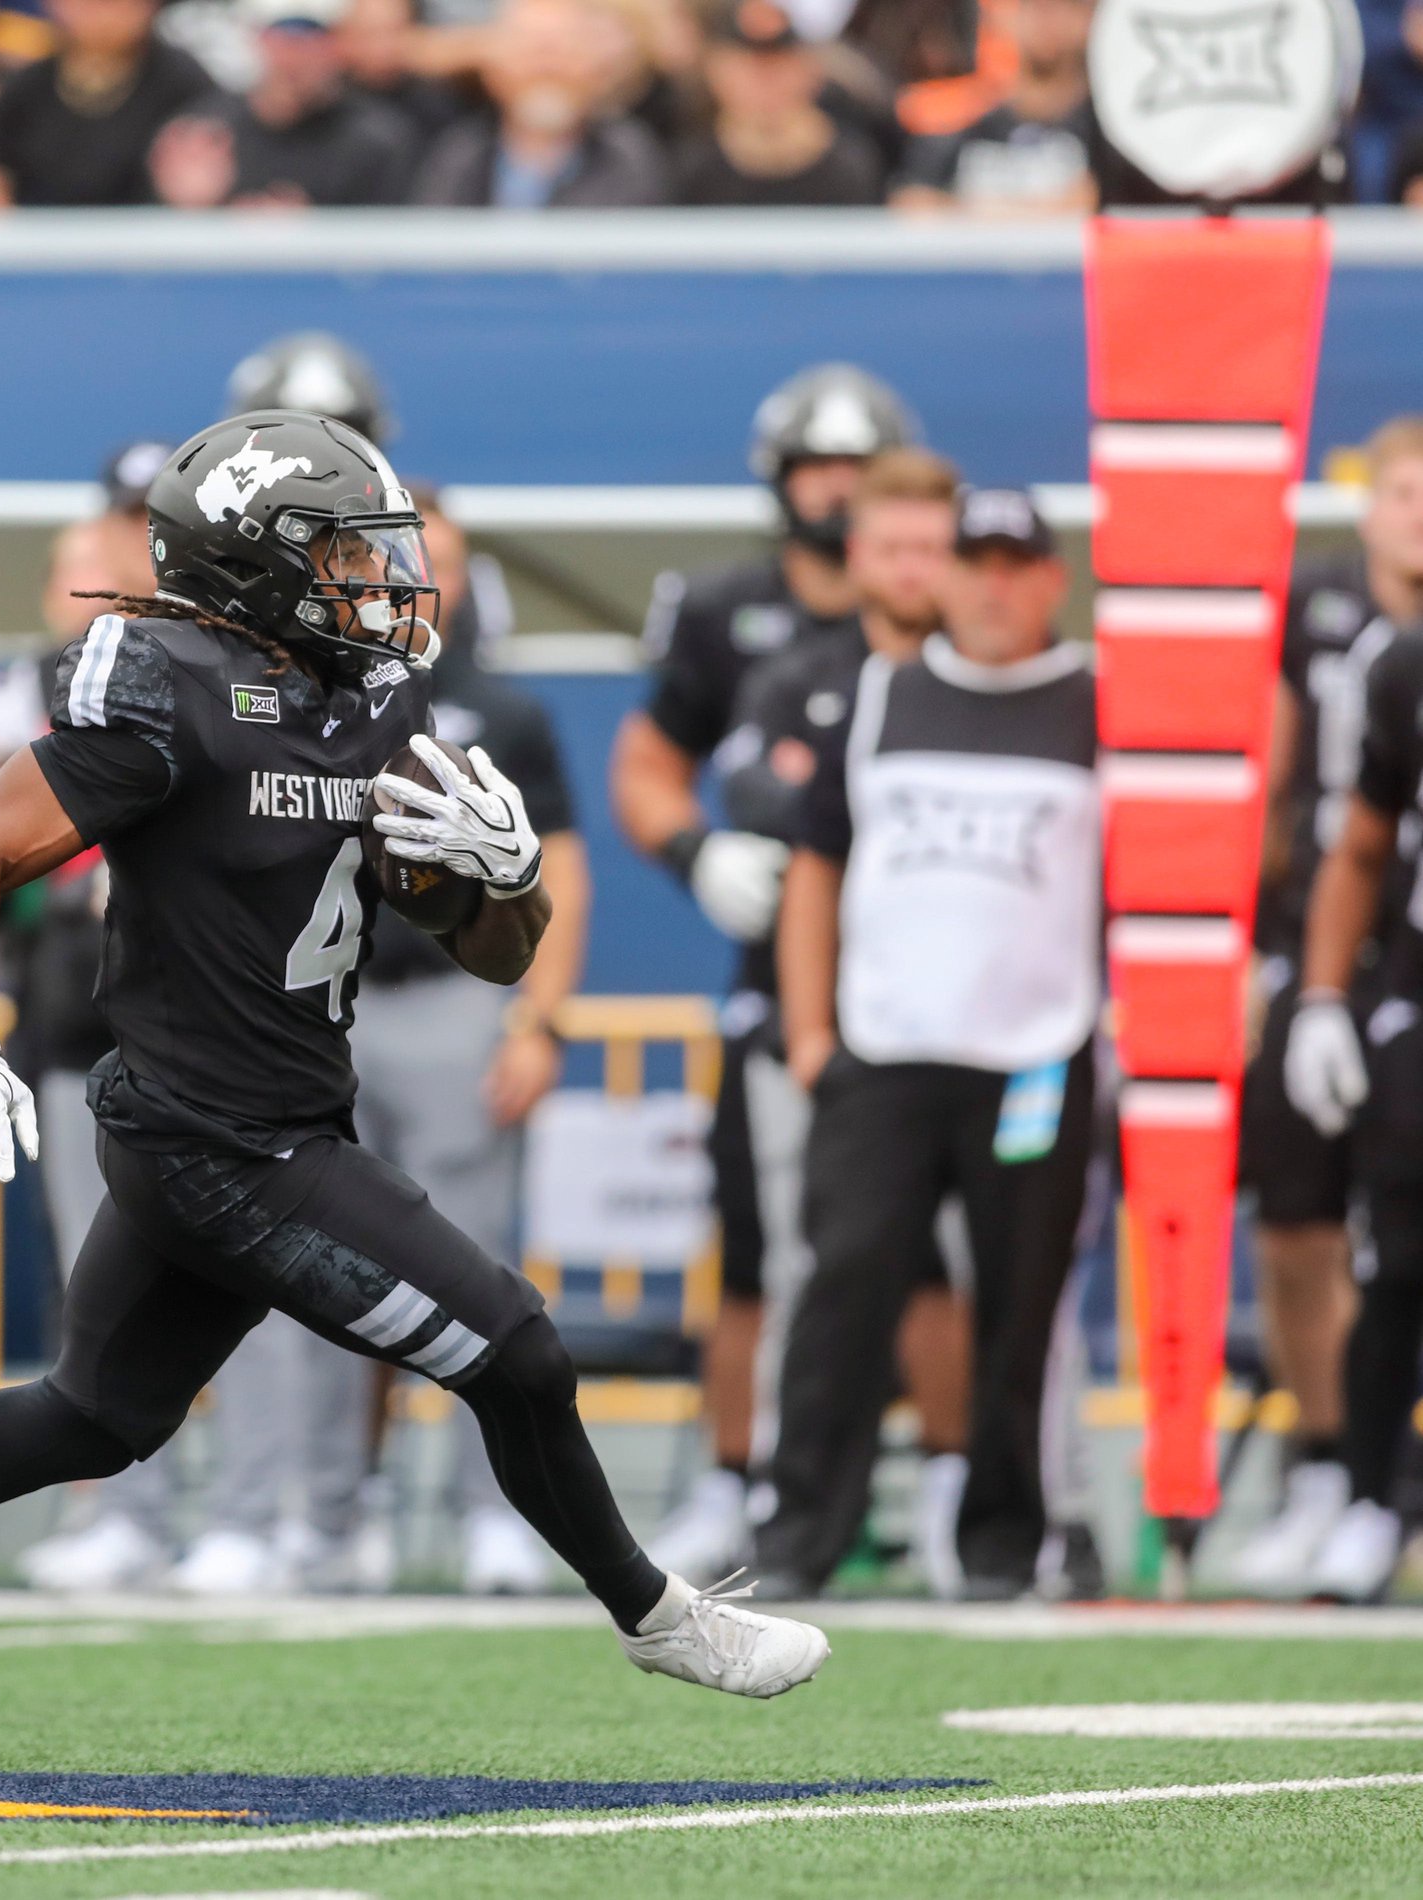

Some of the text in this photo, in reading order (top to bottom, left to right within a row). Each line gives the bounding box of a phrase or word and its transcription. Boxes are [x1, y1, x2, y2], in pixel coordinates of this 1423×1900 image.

[249, 771, 369, 822] WEST VIRG
[285, 836, 363, 1020] 4
